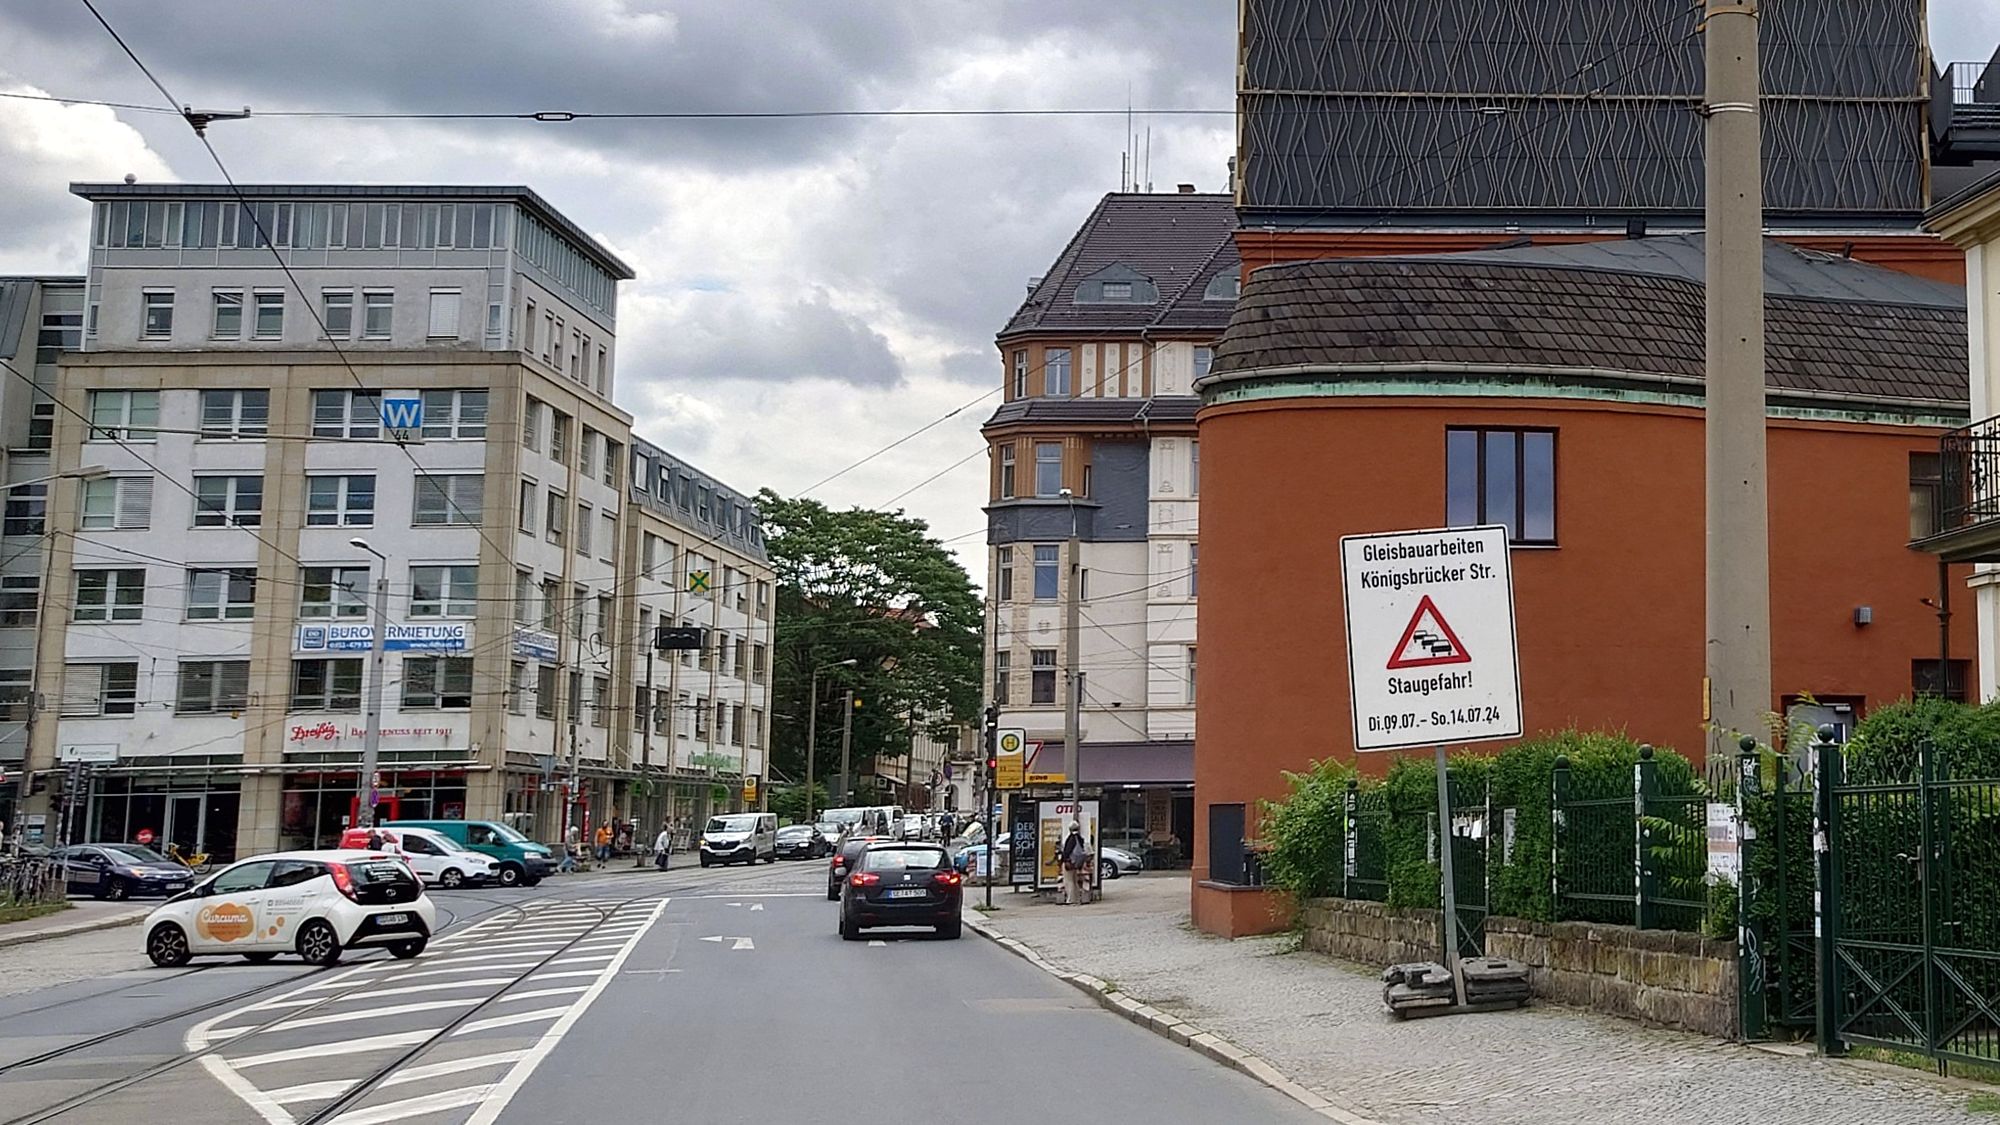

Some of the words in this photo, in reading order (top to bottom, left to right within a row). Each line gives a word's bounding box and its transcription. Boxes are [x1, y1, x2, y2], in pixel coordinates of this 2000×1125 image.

[386, 403, 419, 427] W
[1363, 538, 1484, 562] Gleisbauarbeiten
[1361, 565, 1465, 590] Königsbrücker
[1470, 563, 1496, 580] Str.
[331, 626, 463, 638] BÜROVRMIETUNG
[1388, 671, 1473, 696] Staugefahr!
[1431, 706, 1500, 726] So.14.07.24
